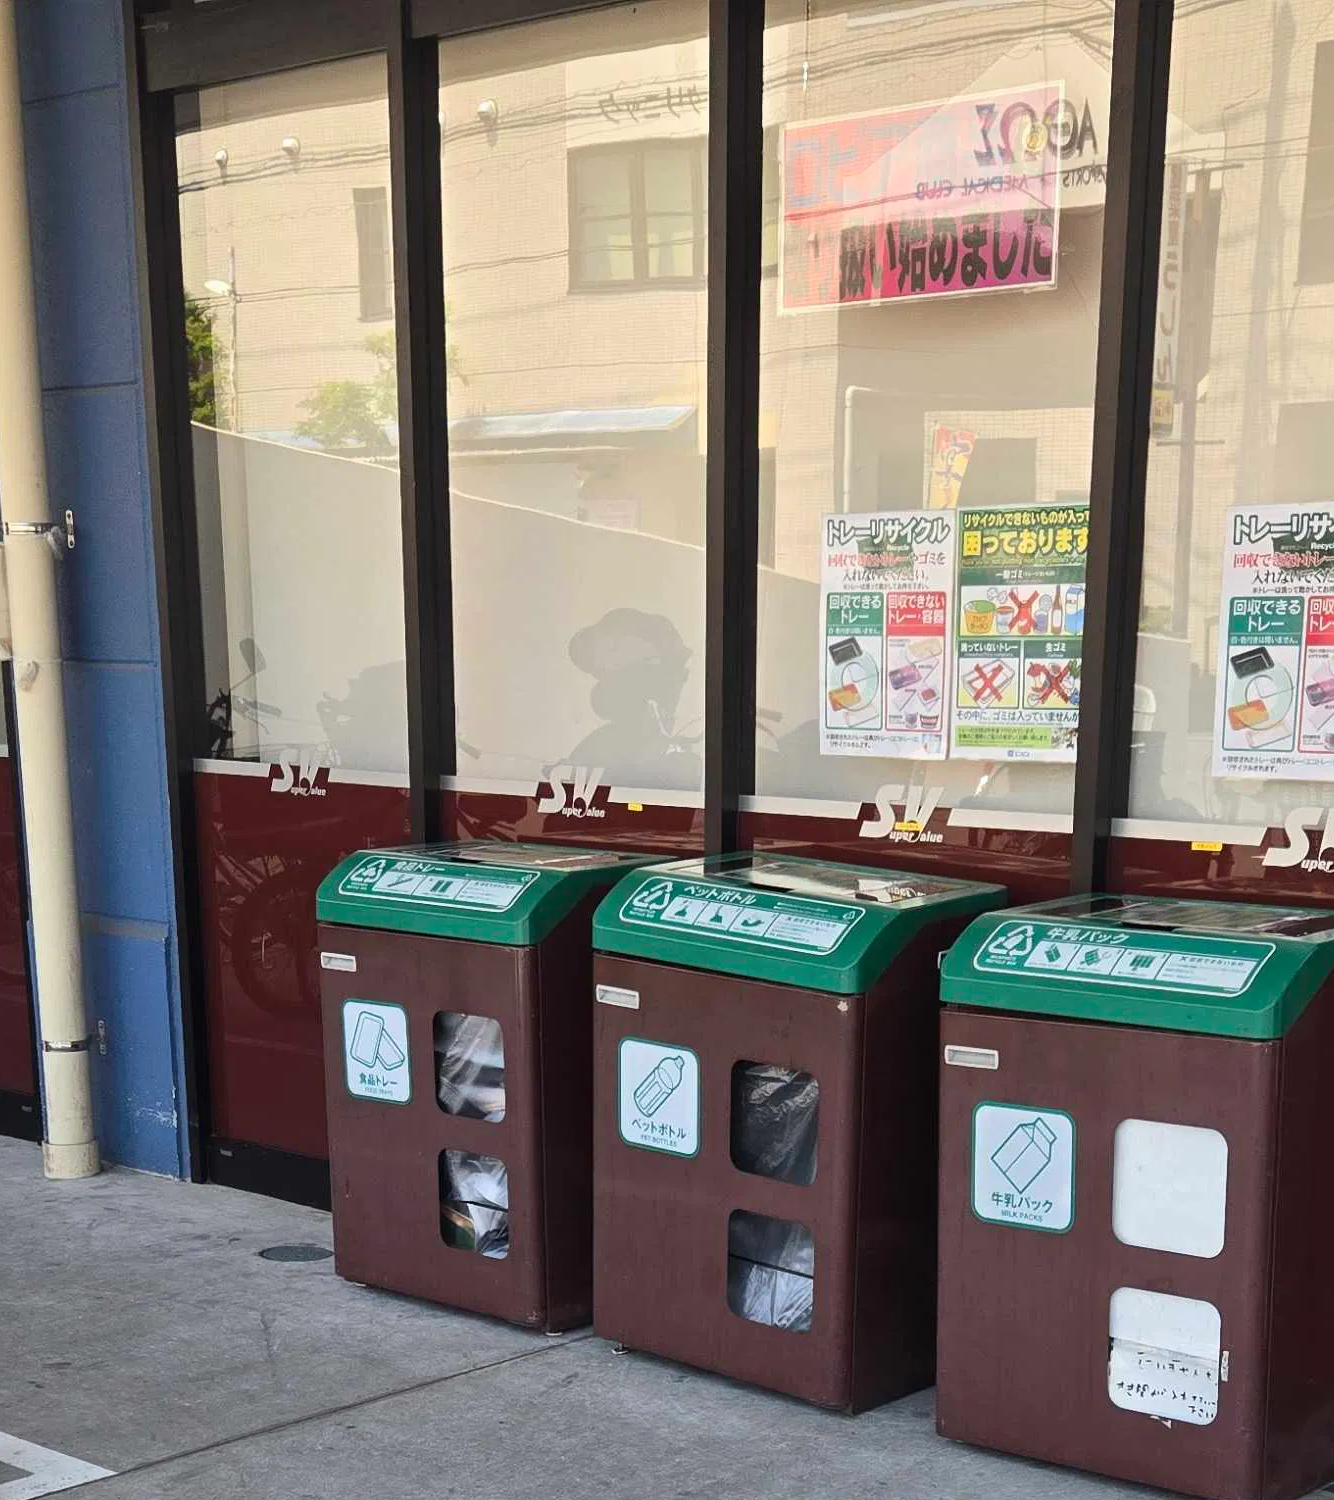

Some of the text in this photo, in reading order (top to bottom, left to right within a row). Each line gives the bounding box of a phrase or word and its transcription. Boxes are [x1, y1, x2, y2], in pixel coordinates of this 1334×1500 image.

[827, 516, 950, 547] トレーリサイクル
[963, 527, 1088, 556] 困っております
[829, 594, 881, 609] 回収できる
[888, 593, 944, 609] 回収できない
[1233, 599, 1301, 615] 回収できる
[841, 609, 869, 624] トレー
[1247, 616, 1285, 632] トレー
[684, 886, 757, 904] ペットボトル
[1046, 927, 1130, 945] 牛乳パック
[359, 1072, 398, 1087] 食品トレー
[631, 1117, 687, 1140] ペットボトル
[991, 1191, 1053, 1214] 牛乳パック
[1001, 1210, 1017, 1219] MILK
